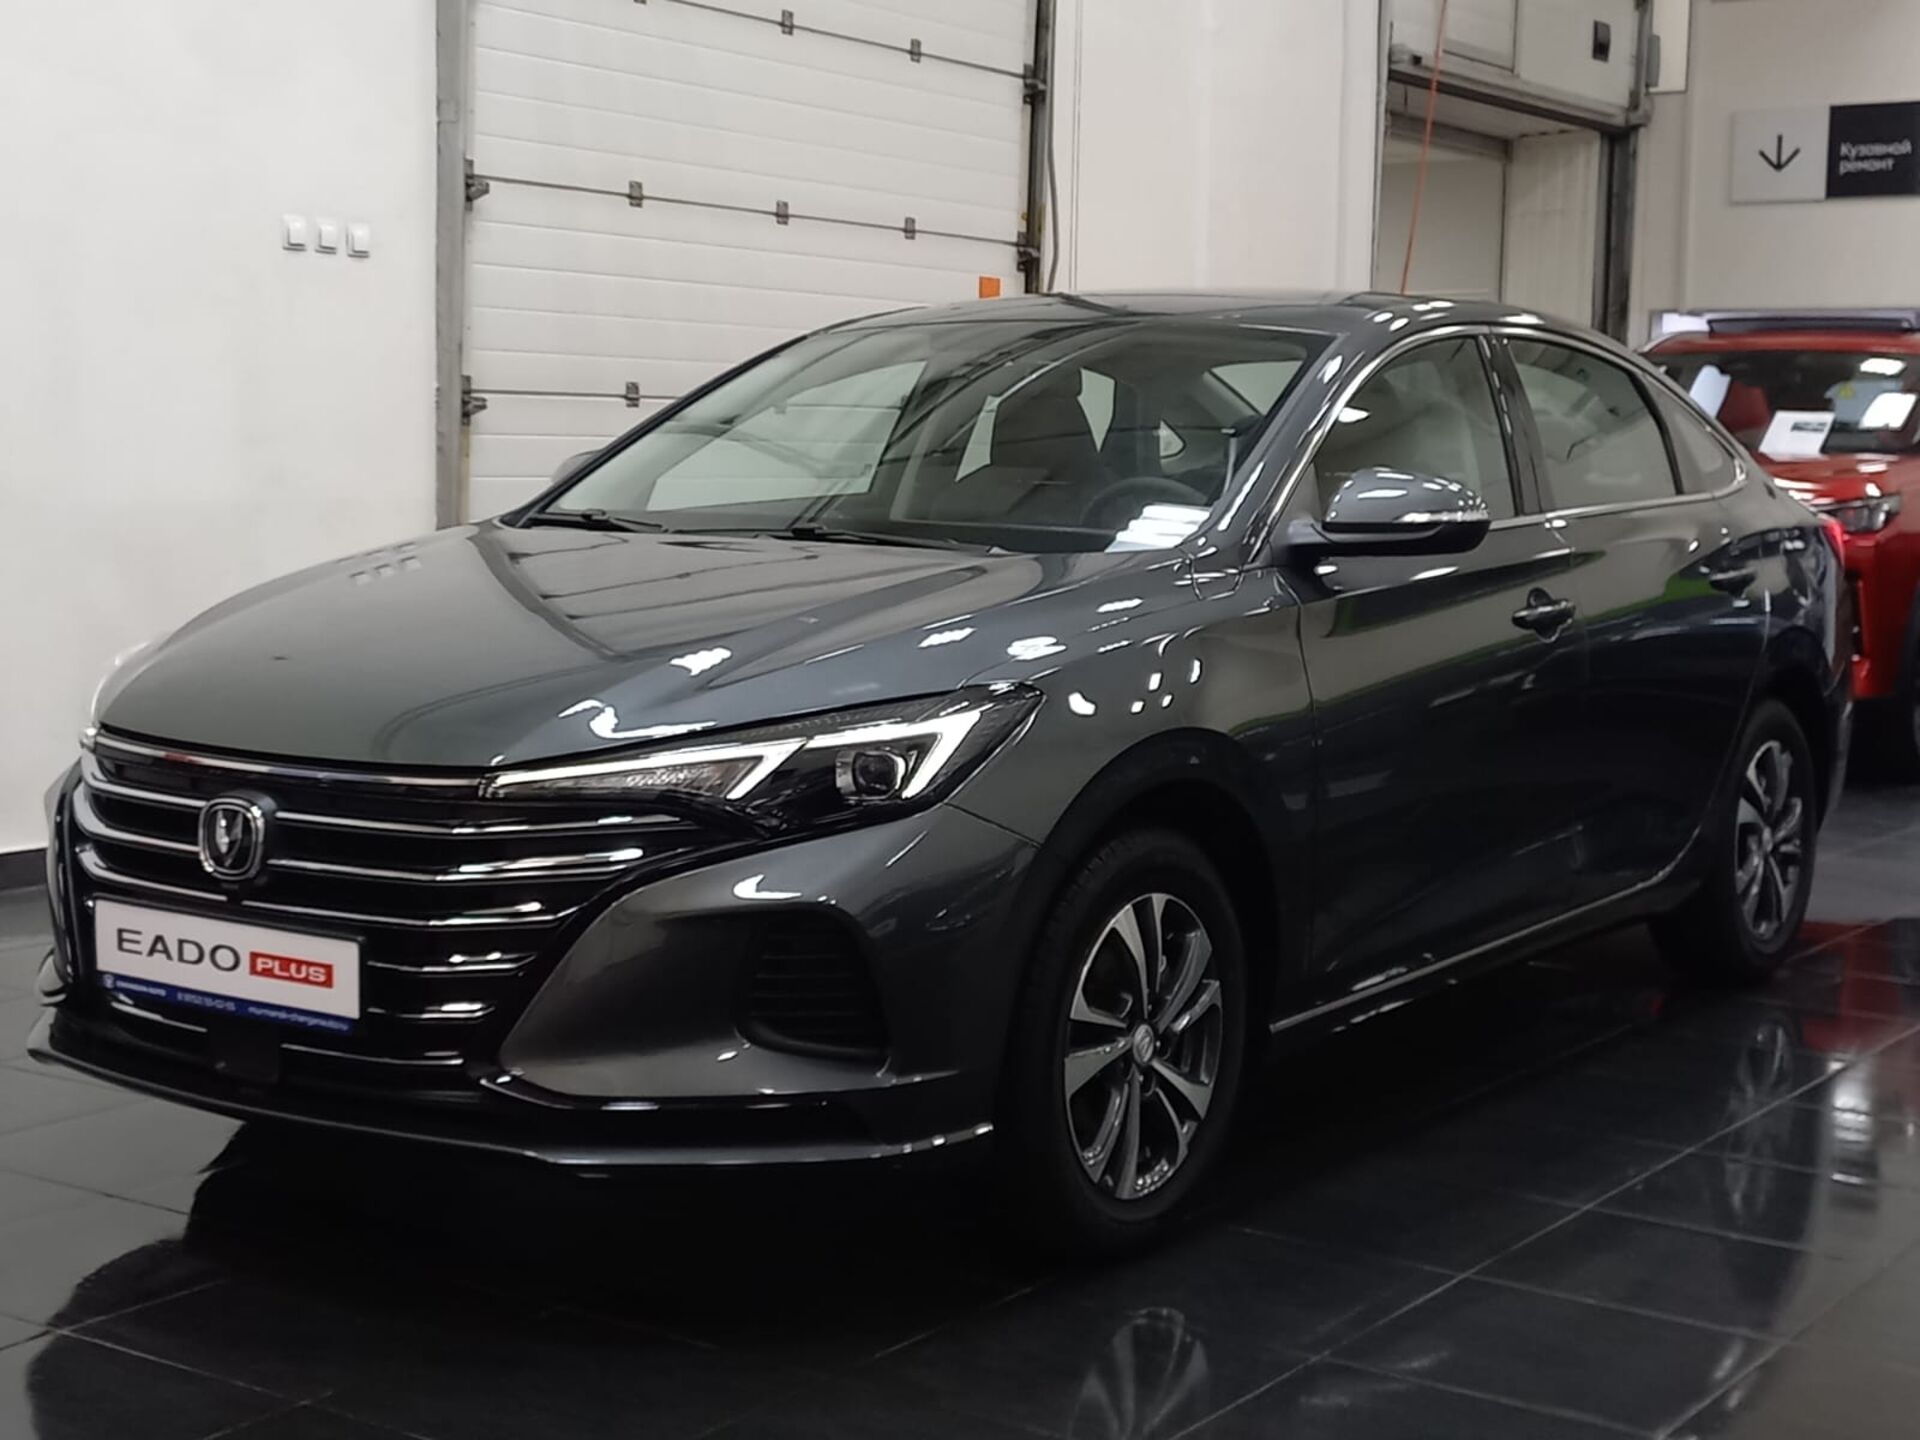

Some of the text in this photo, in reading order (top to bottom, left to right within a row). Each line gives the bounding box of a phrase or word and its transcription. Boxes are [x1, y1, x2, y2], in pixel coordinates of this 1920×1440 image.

[1840, 139, 1912, 160] Кузовной
[1839, 158, 1895, 176] ремонт
[116, 927, 327, 983] EADO PLUS
